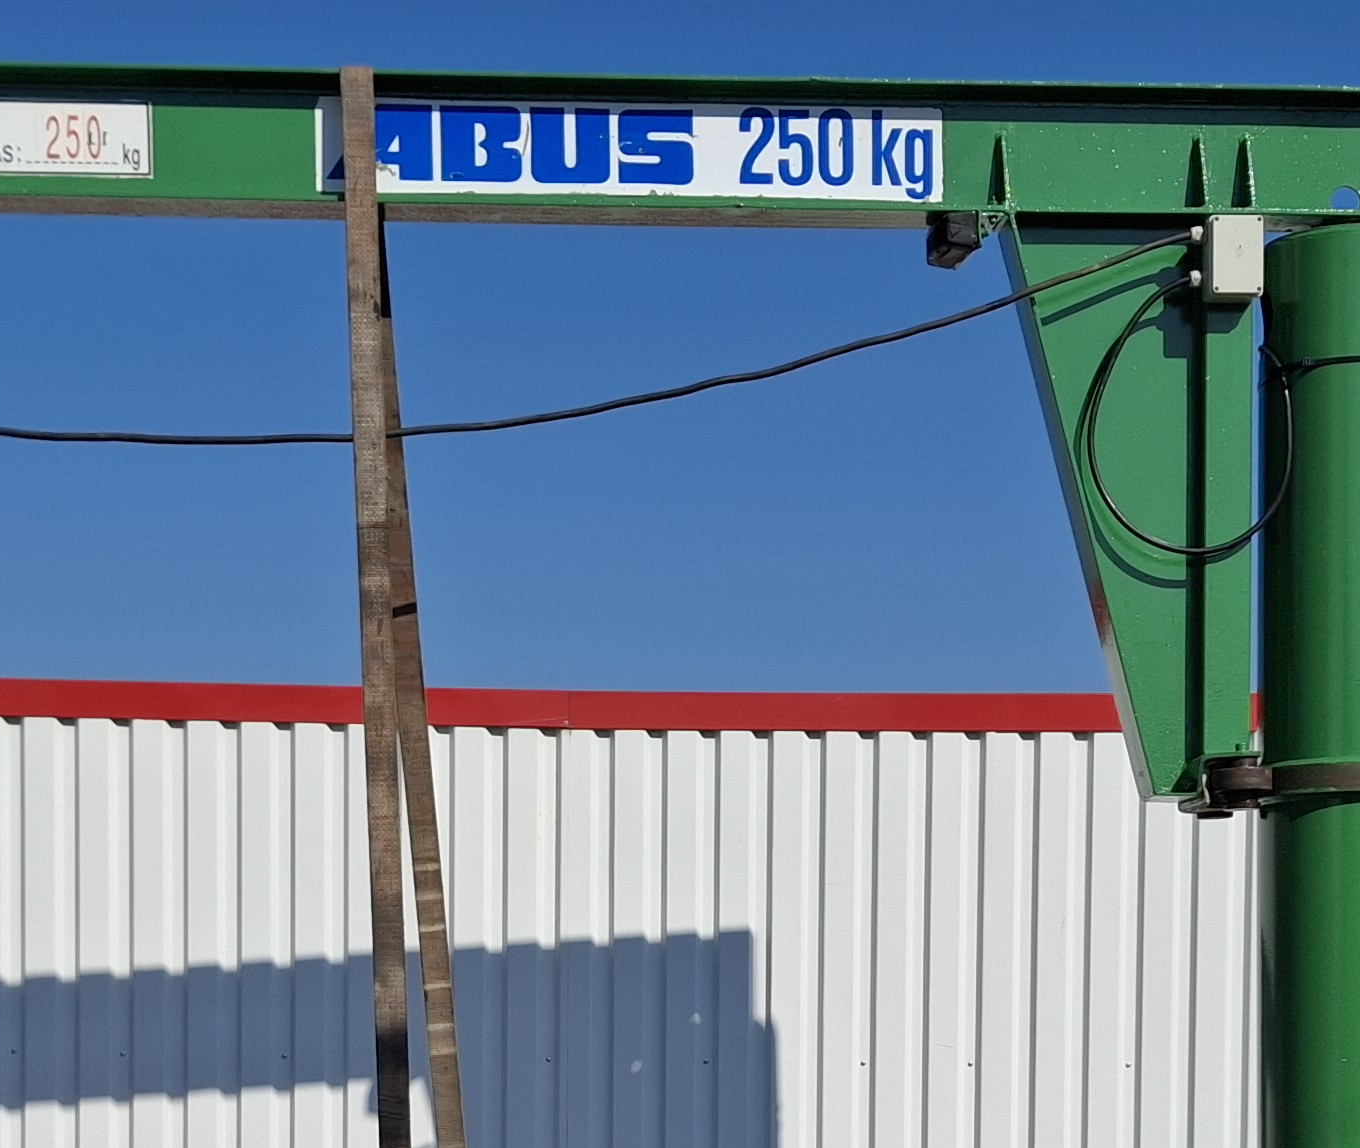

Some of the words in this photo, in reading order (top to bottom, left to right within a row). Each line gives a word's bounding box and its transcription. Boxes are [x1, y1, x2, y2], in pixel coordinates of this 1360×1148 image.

[45, 115, 102, 160] 250
[122, 143, 141, 171] kg
[326, 104, 694, 185] ABUS
[738, 107, 854, 186] 250
[872, 109, 934, 199] kg
